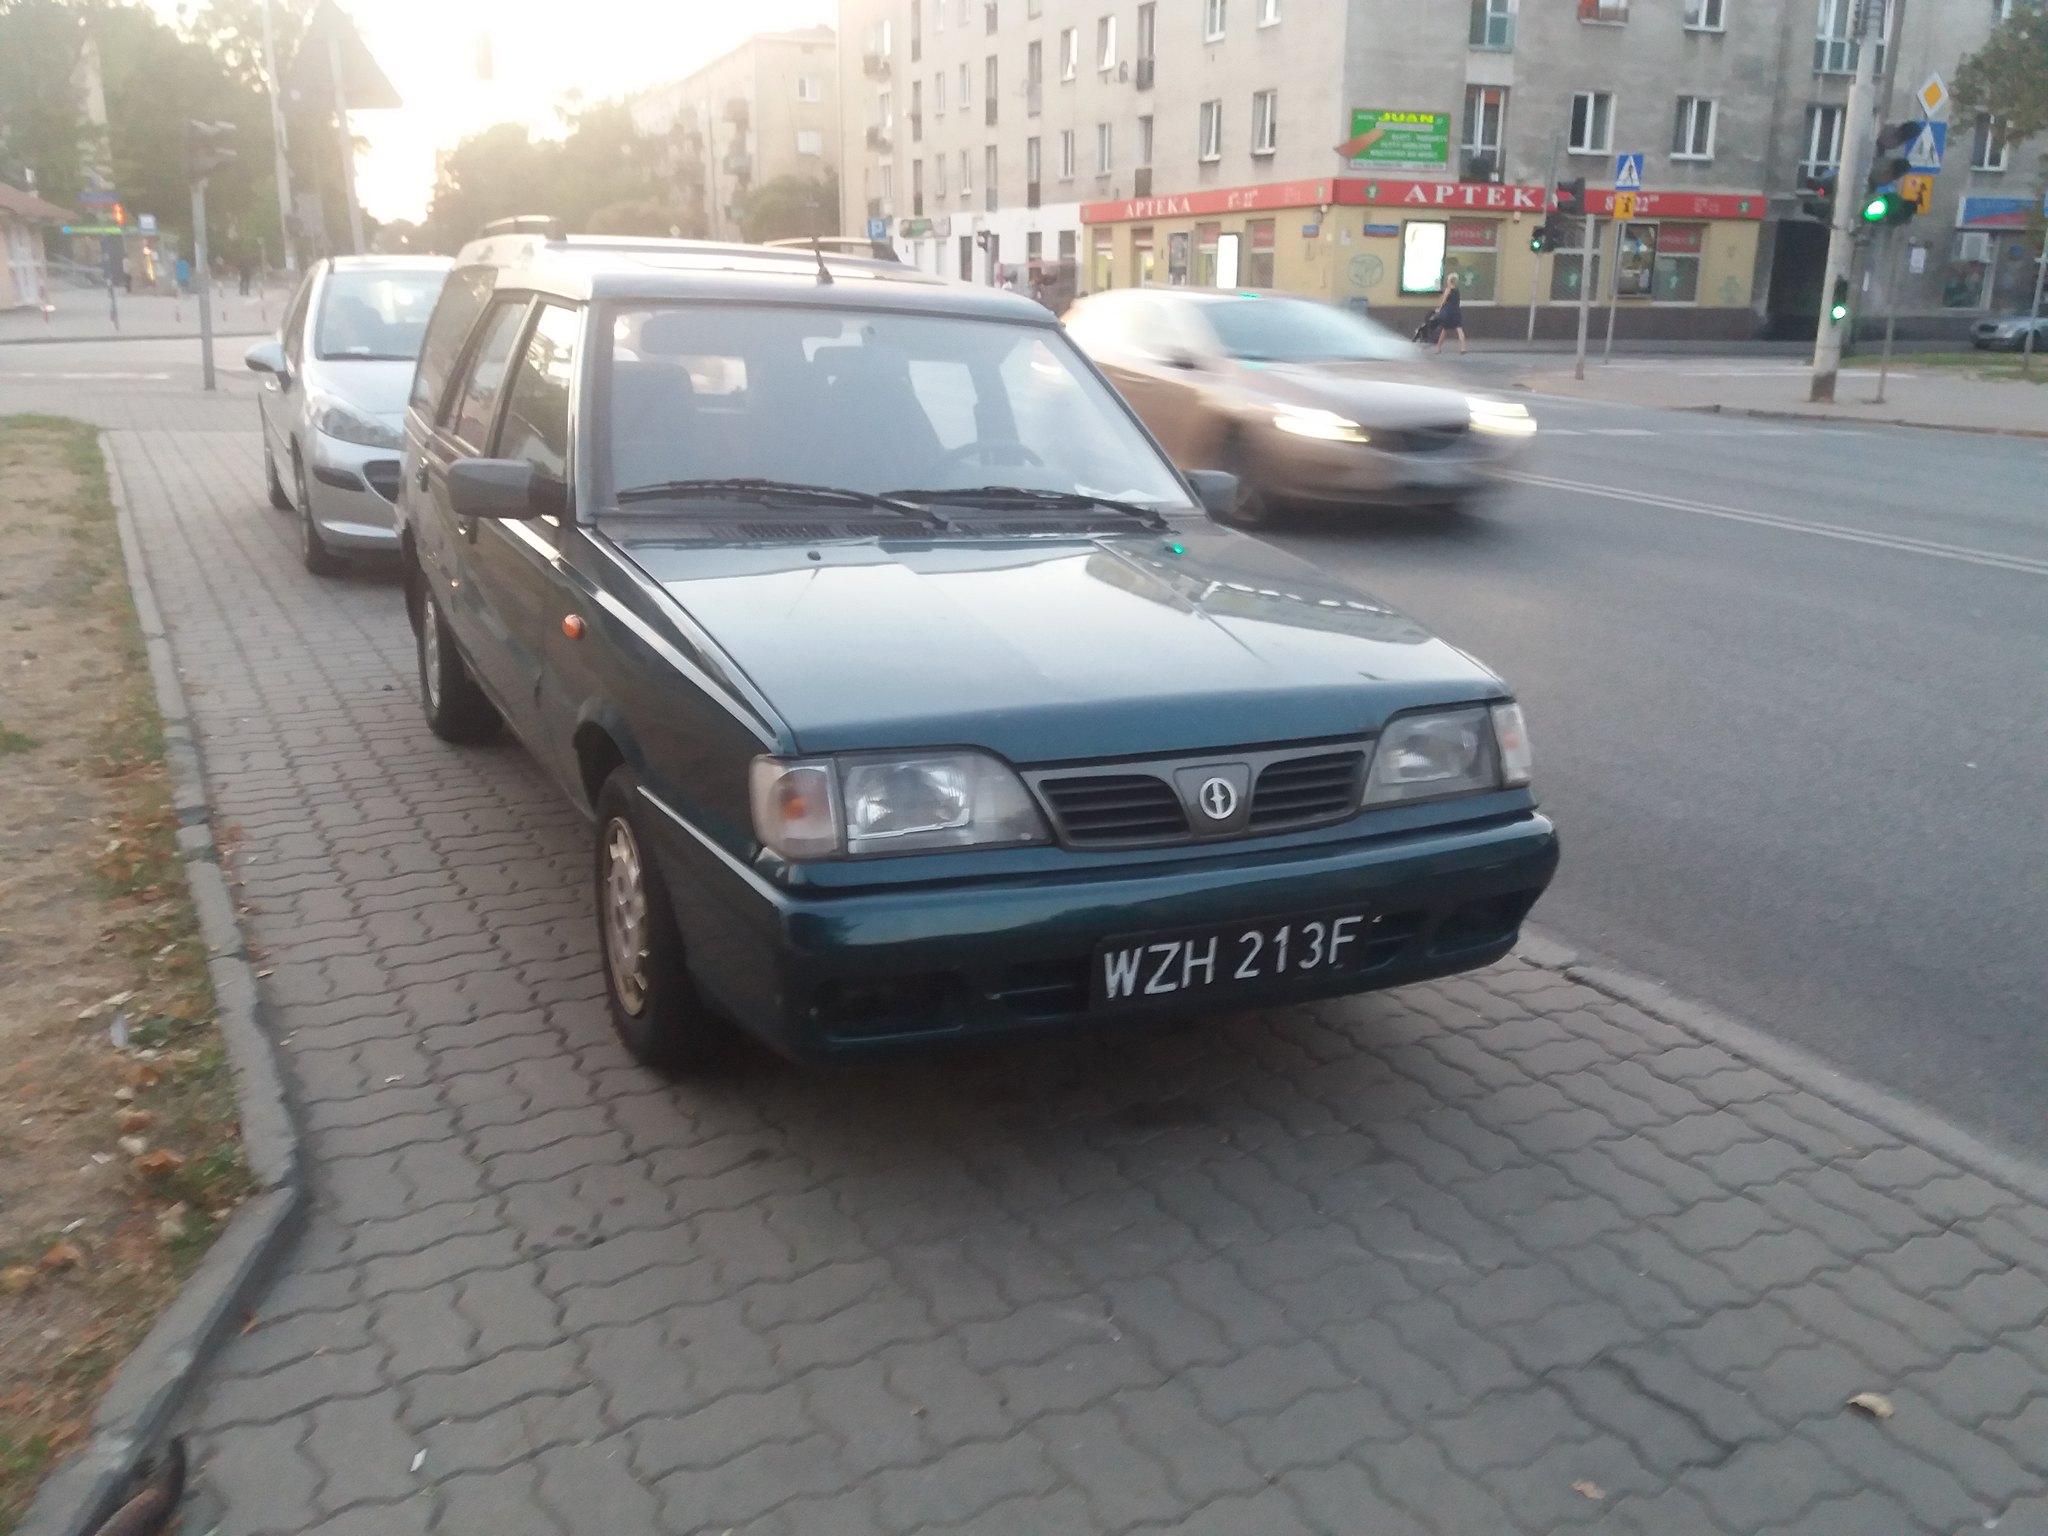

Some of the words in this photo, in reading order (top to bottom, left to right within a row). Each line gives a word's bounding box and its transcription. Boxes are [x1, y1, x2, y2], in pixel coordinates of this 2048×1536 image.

[1379, 112, 1434, 123] JUAN
[1125, 197, 1191, 217] APTEKA
[1104, 936, 1218, 998] WZH
[1234, 915, 1363, 979] 213F
